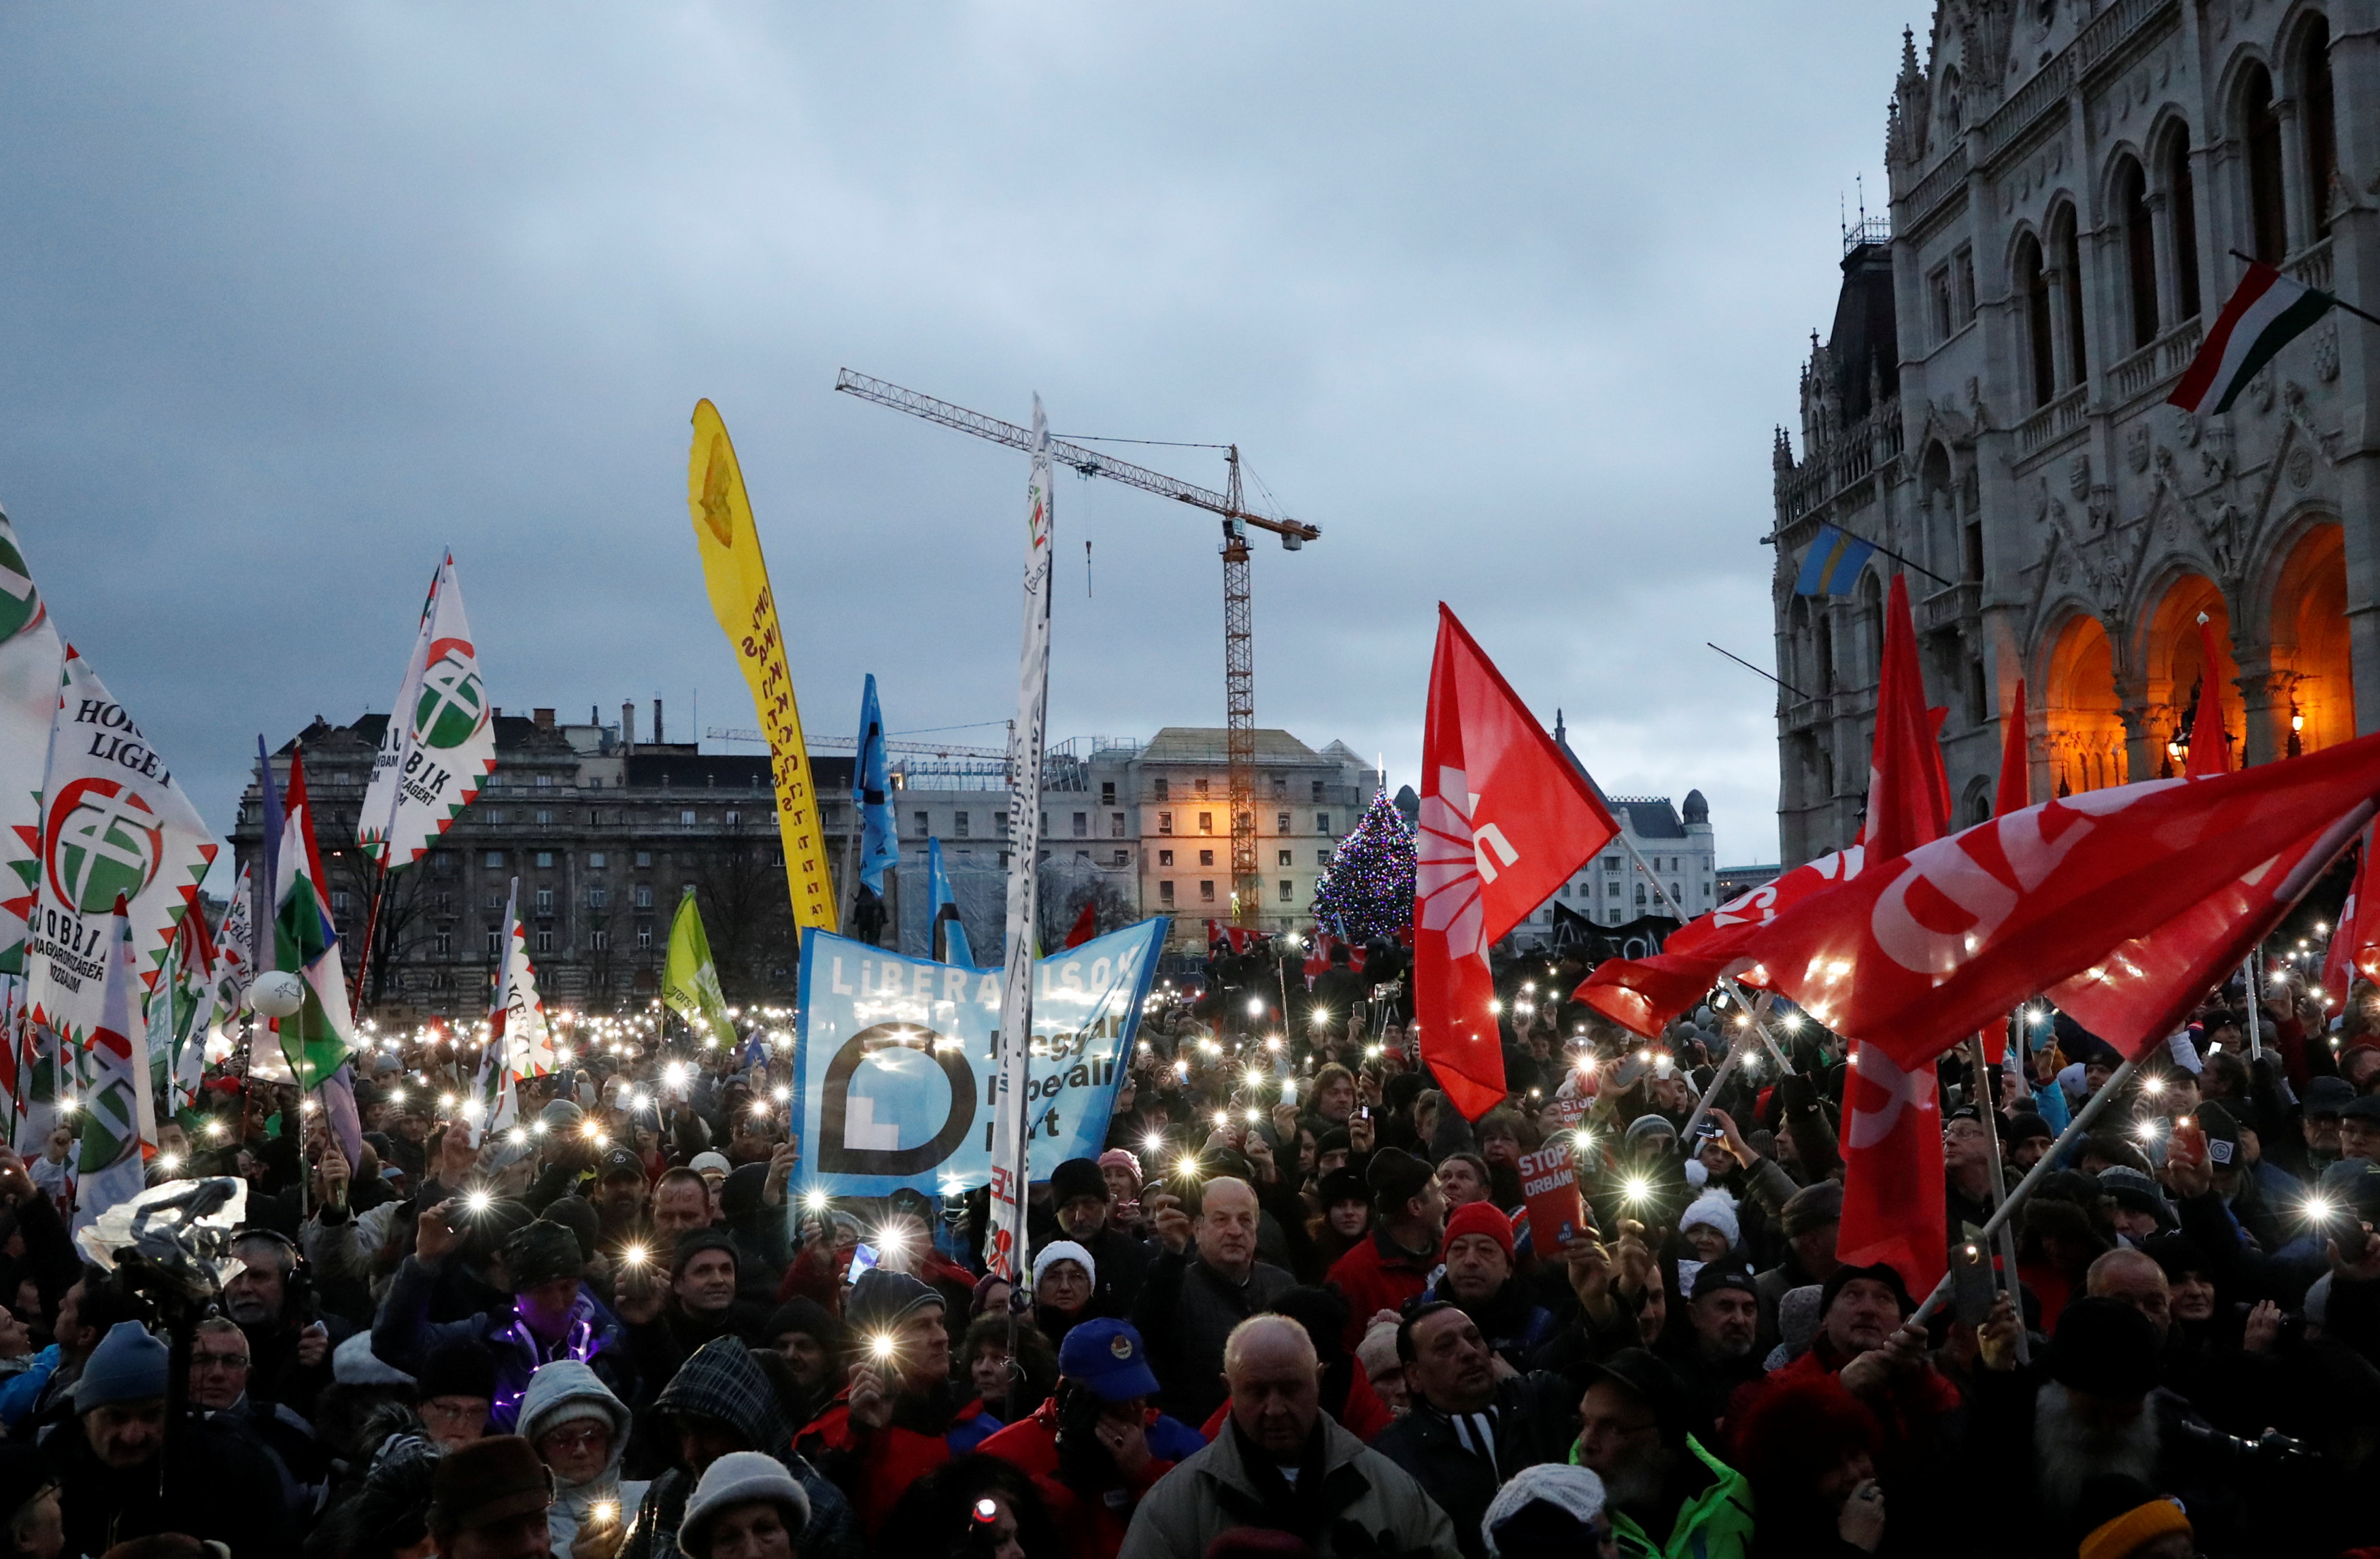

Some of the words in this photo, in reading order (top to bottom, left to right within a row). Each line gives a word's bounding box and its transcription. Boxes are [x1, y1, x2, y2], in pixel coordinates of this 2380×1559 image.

[405, 750, 451, 795] BIK
[401, 775, 436, 806] ZÁGÉRT
[36, 904, 107, 962] JOBBI
[1561, 1096, 1595, 1112] STOP
[1564, 1112, 1582, 1122] ORB
[1518, 1144, 1567, 1176] STOP
[1525, 1169, 1574, 1197] ORBÁN!
